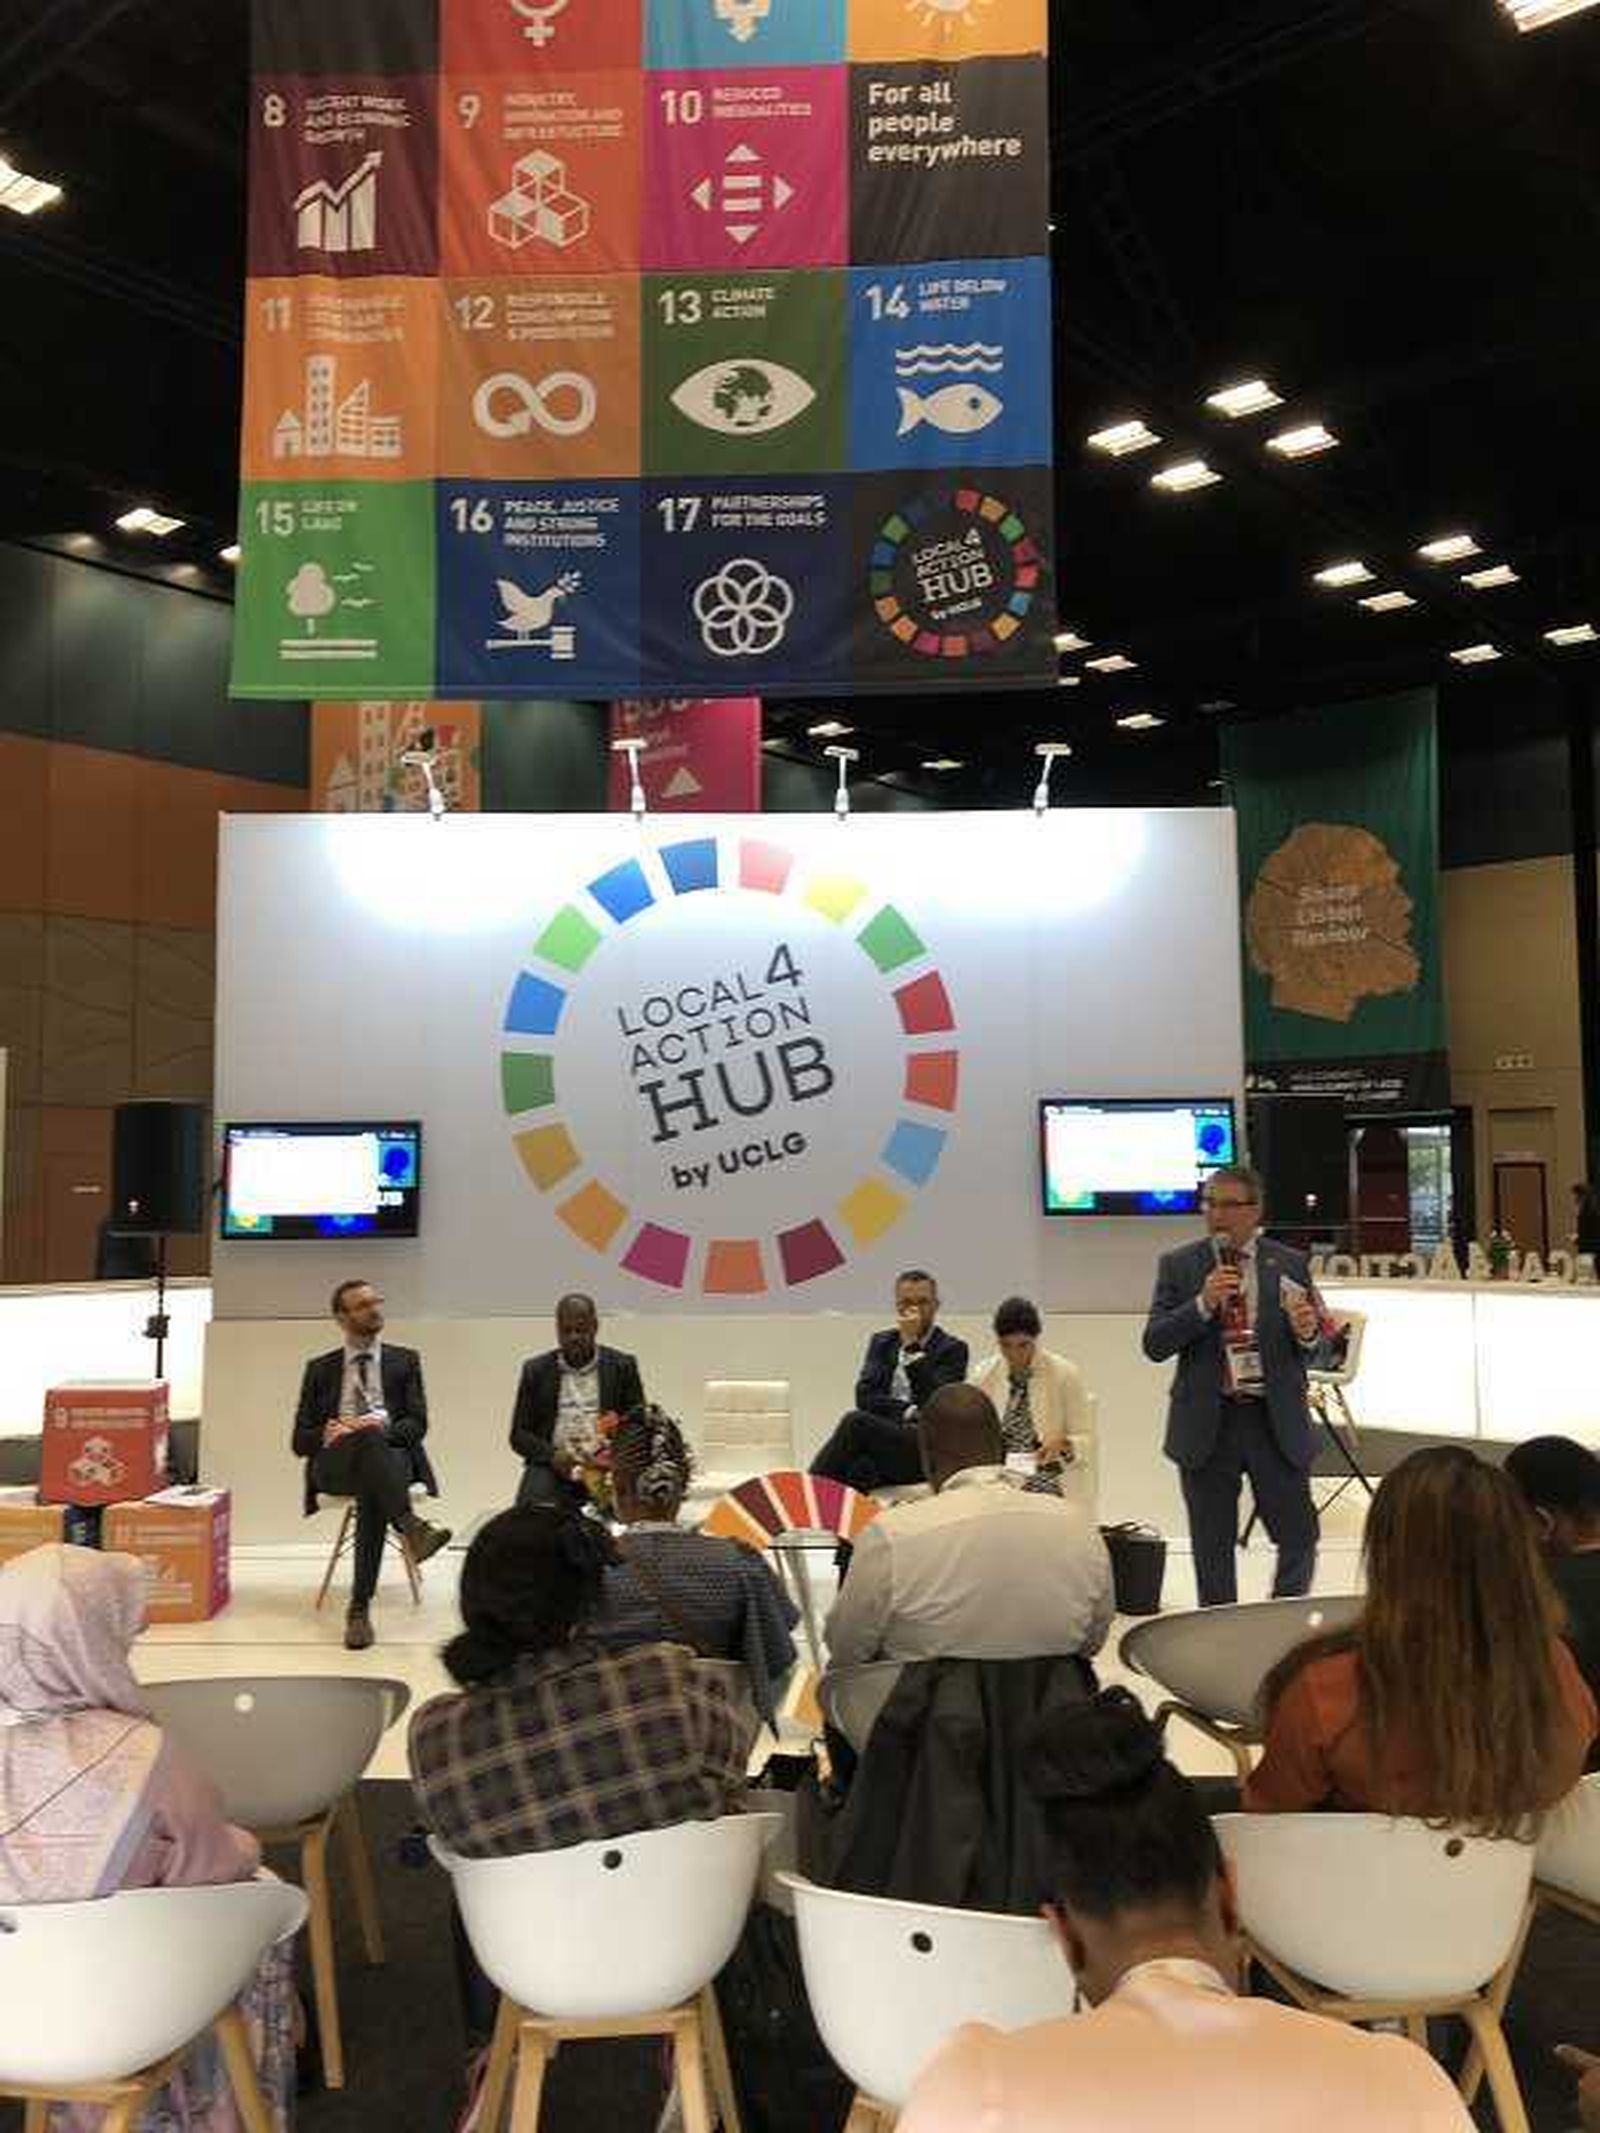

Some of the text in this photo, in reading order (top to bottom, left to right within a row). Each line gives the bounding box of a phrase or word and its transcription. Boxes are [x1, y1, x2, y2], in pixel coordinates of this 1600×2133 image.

[660, 89, 702, 125] 10
[868, 82, 952, 104] For all
[264, 94, 286, 128] 8
[458, 95, 481, 129] 9
[868, 111, 955, 139] people
[868, 135, 1022, 167] everywhere
[261, 298, 291, 332] 11
[455, 295, 495, 330] 12
[658, 290, 702, 325] 13
[864, 284, 911, 320] 14
[256, 501, 295, 536] 15
[451, 498, 494, 533] 16
[658, 497, 702, 532] 17
[917, 562, 993, 602] HUB
[618, 943, 804, 1036] LOCAL 4
[631, 996, 811, 1076] ACTION
[639, 1036, 834, 1143] HUB
[670, 1131, 807, 1189] by UCLG
